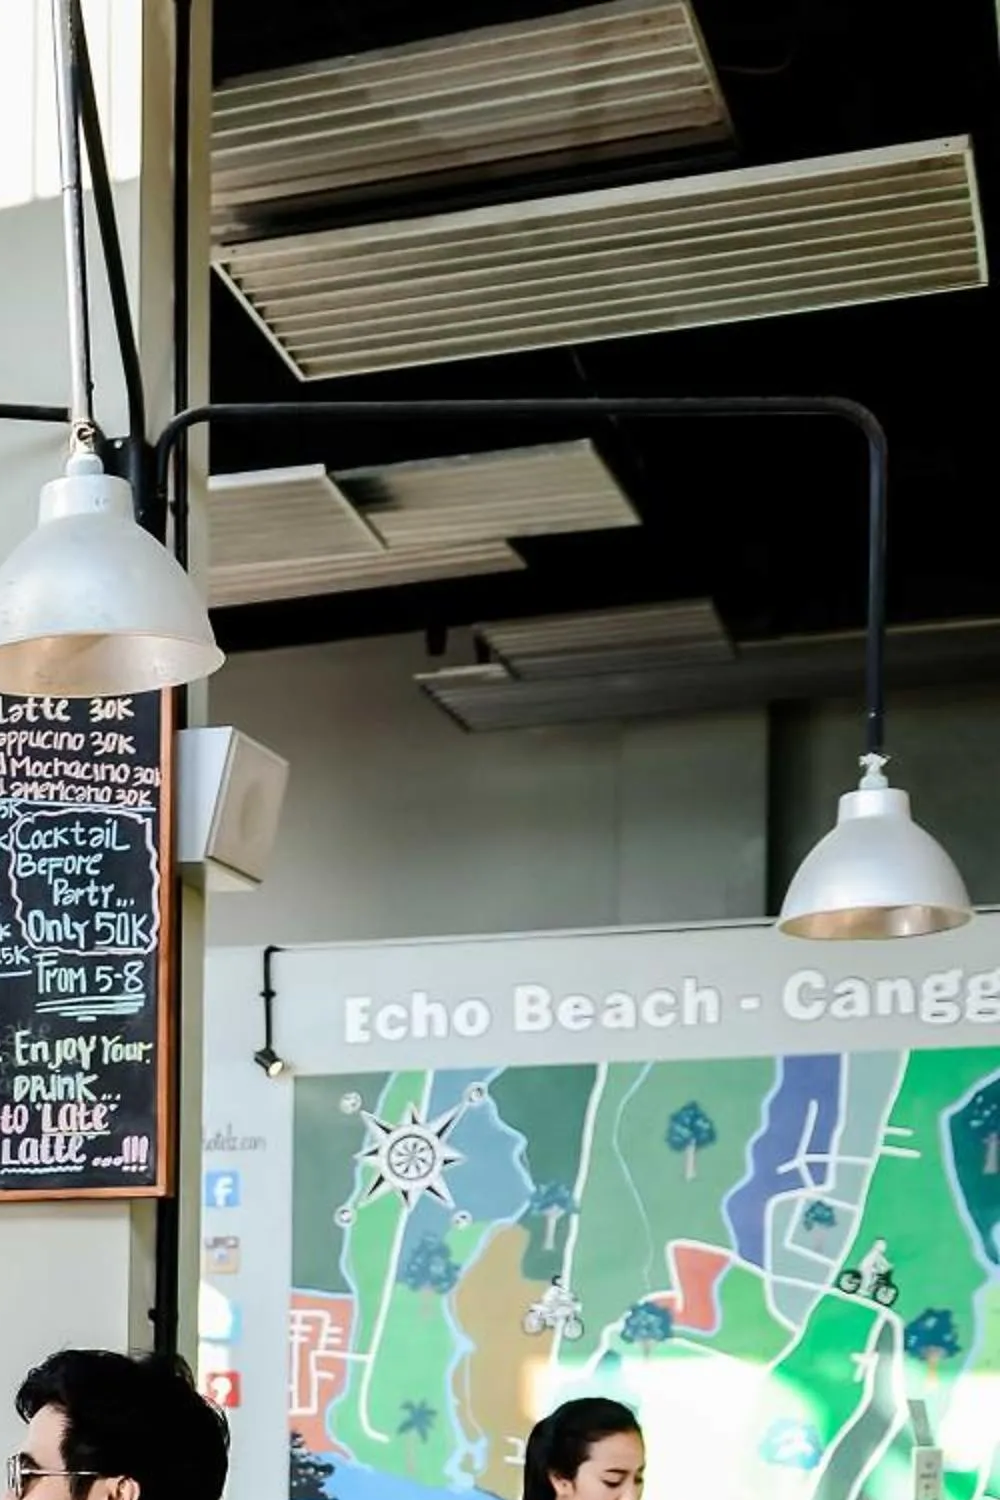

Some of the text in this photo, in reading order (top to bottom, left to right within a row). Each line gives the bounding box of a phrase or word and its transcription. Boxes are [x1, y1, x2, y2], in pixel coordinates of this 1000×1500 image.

[89, 697, 135, 722] 30K
[90, 731, 137, 756] 30K
[115, 789, 153, 807] 30K
[94, 911, 151, 947] 50K
[95, 960, 145, 993] 5-8
[344, 990, 491, 1045] Echo
[513, 977, 721, 1035] Beach
[0, 1104, 28, 1134] to
